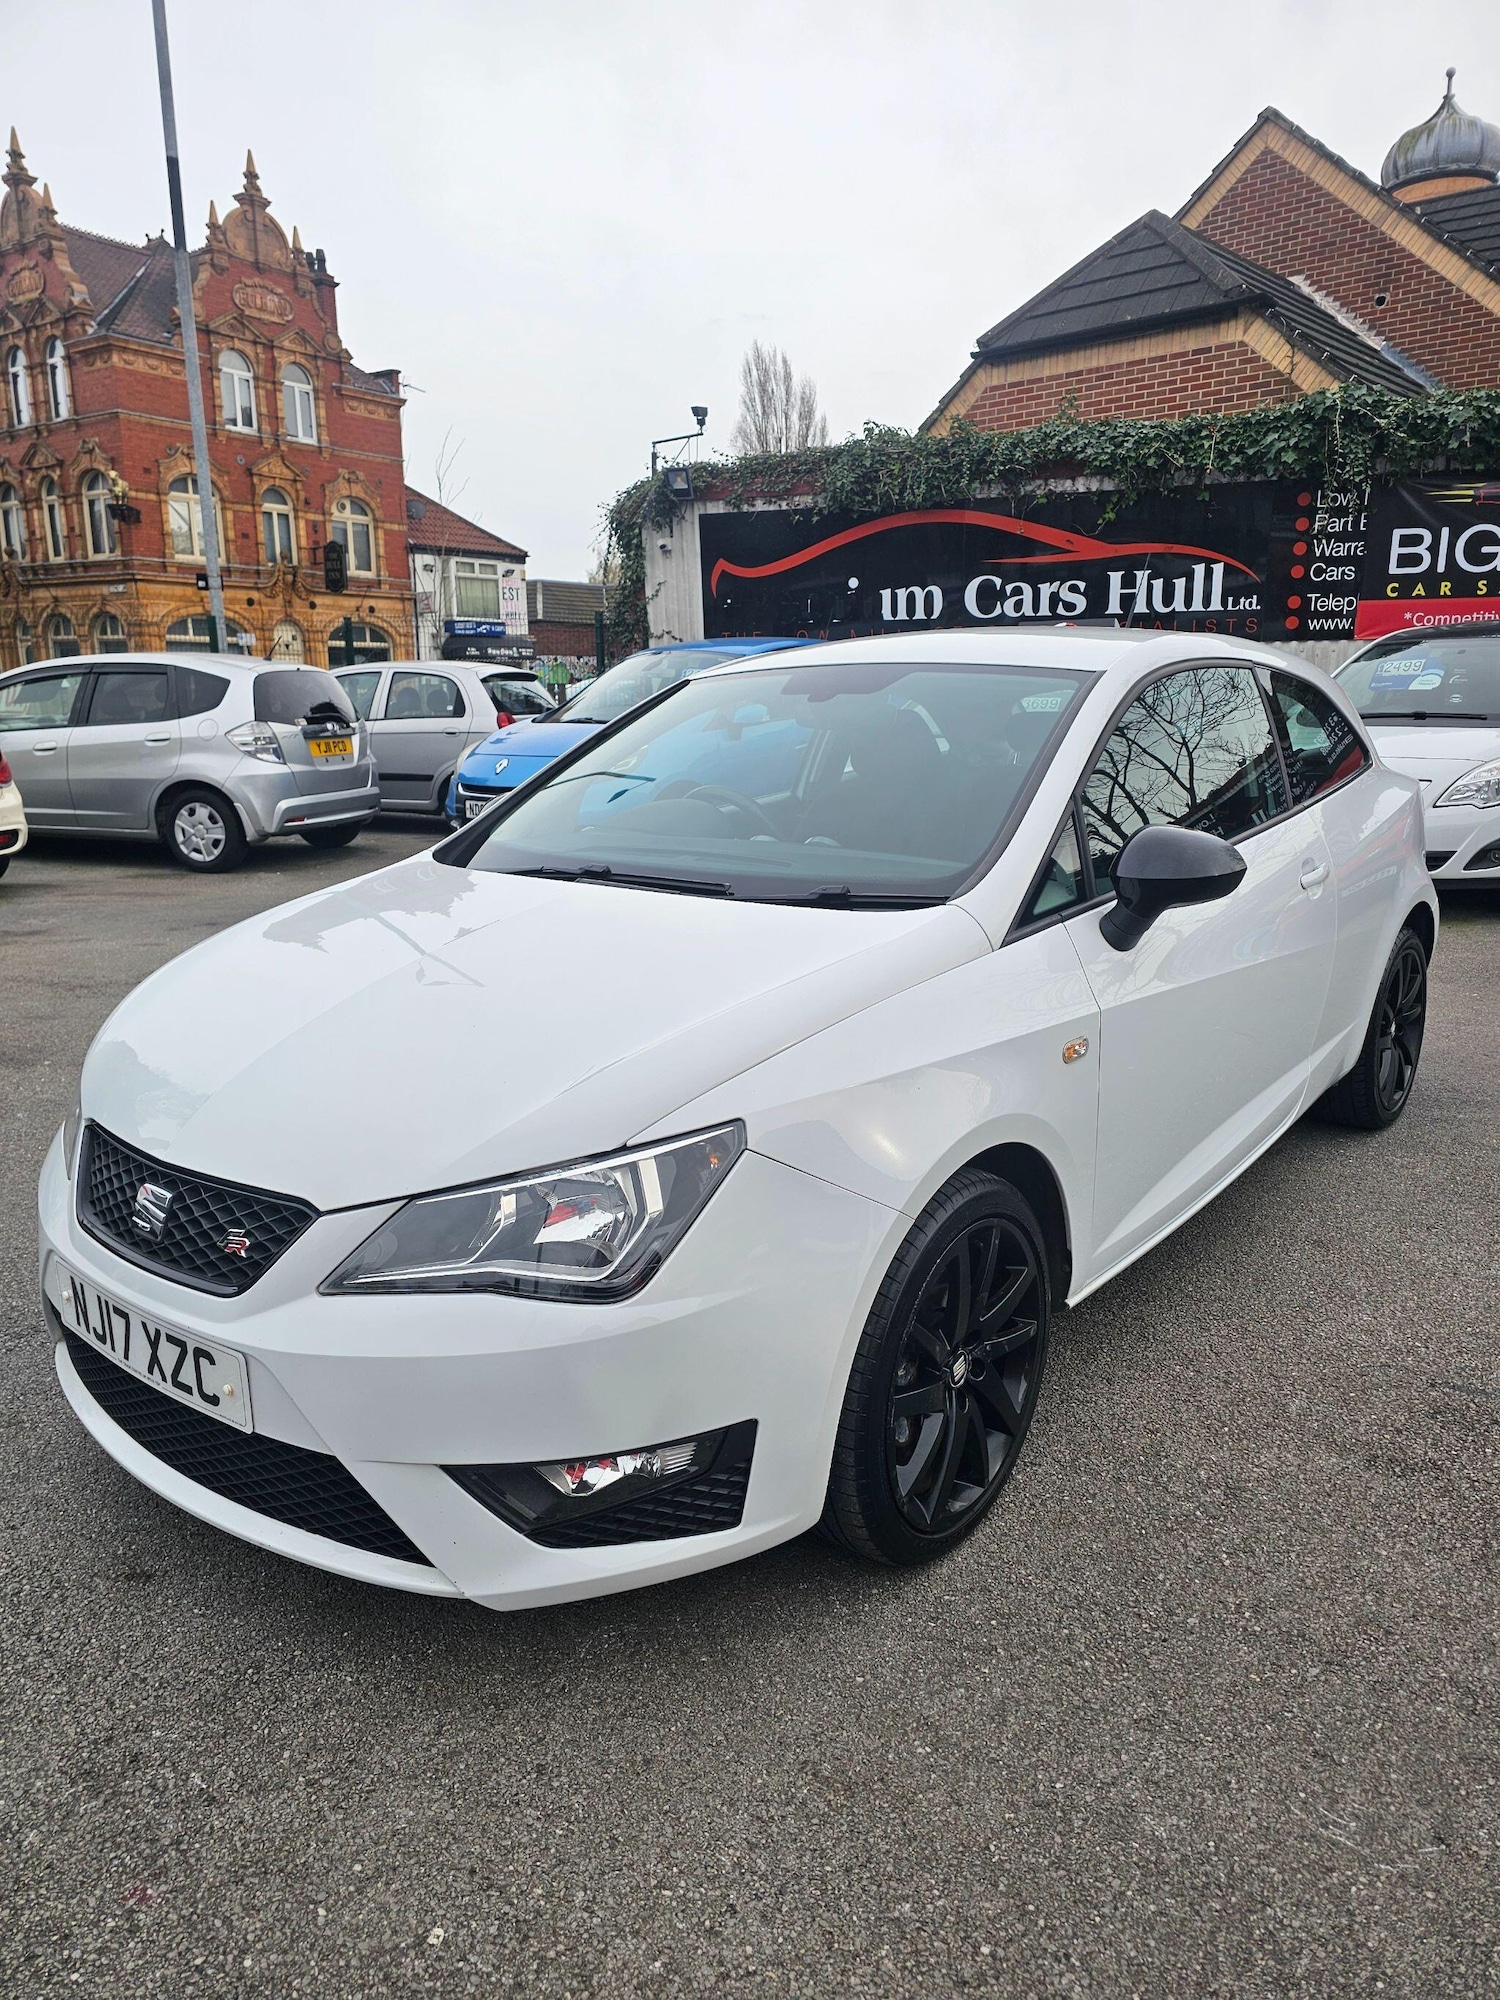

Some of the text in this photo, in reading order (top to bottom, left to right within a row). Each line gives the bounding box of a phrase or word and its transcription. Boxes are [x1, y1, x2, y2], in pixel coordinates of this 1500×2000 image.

[1315, 514, 1353, 533] Part
[1388, 523, 1500, 574] BIG
[1310, 562, 1356, 582] Cars
[964, 574, 1087, 619] Cars
[1104, 562, 1225, 615] Hull
[1226, 595, 1262, 611] Ltd.
[1308, 617, 1354, 631] www.
[70, 1275, 221, 1407] NJ17 XZC
